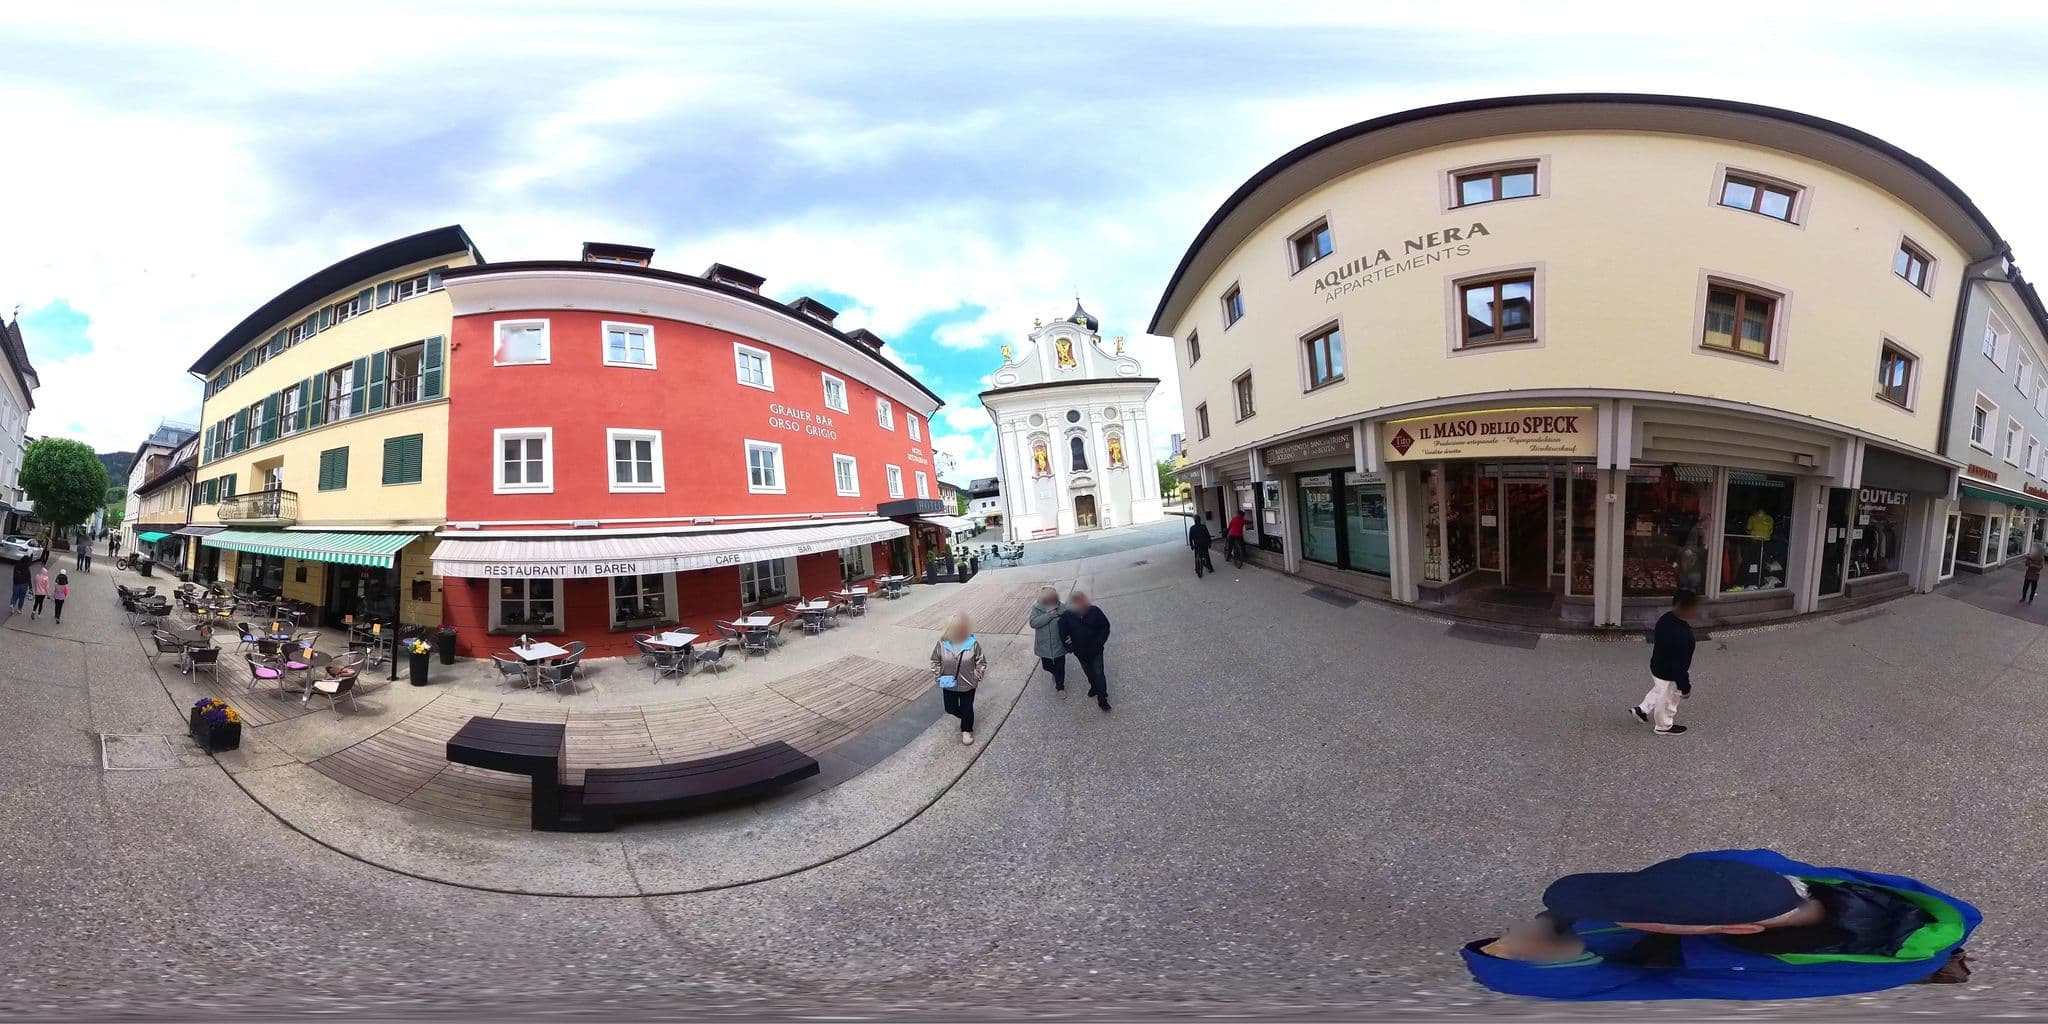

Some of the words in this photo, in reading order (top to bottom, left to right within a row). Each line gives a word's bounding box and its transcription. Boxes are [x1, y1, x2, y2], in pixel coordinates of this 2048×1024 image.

[1313, 248, 1391, 294] AQUILA
[1404, 222, 1491, 254] NERA
[1325, 244, 1471, 304] APPARTEMENTS
[769, 403, 811, 421] GRAUER
[816, 414, 833, 427] BÄR
[769, 416, 800, 432] ORSO
[805, 424, 837, 440] GRIGIO
[1419, 427, 1432, 440] IL
[1433, 419, 1477, 439] MASO
[1480, 421, 1520, 435] DELLO
[1522, 416, 1579, 434] SPECK
[1859, 488, 1908, 505] OUTLET
[715, 554, 741, 565] CAFE
[797, 544, 813, 553] BAR
[484, 565, 567, 576] RESTAURANT
[573, 565, 588, 575] IM
[594, 561, 636, 574] BÄREN
